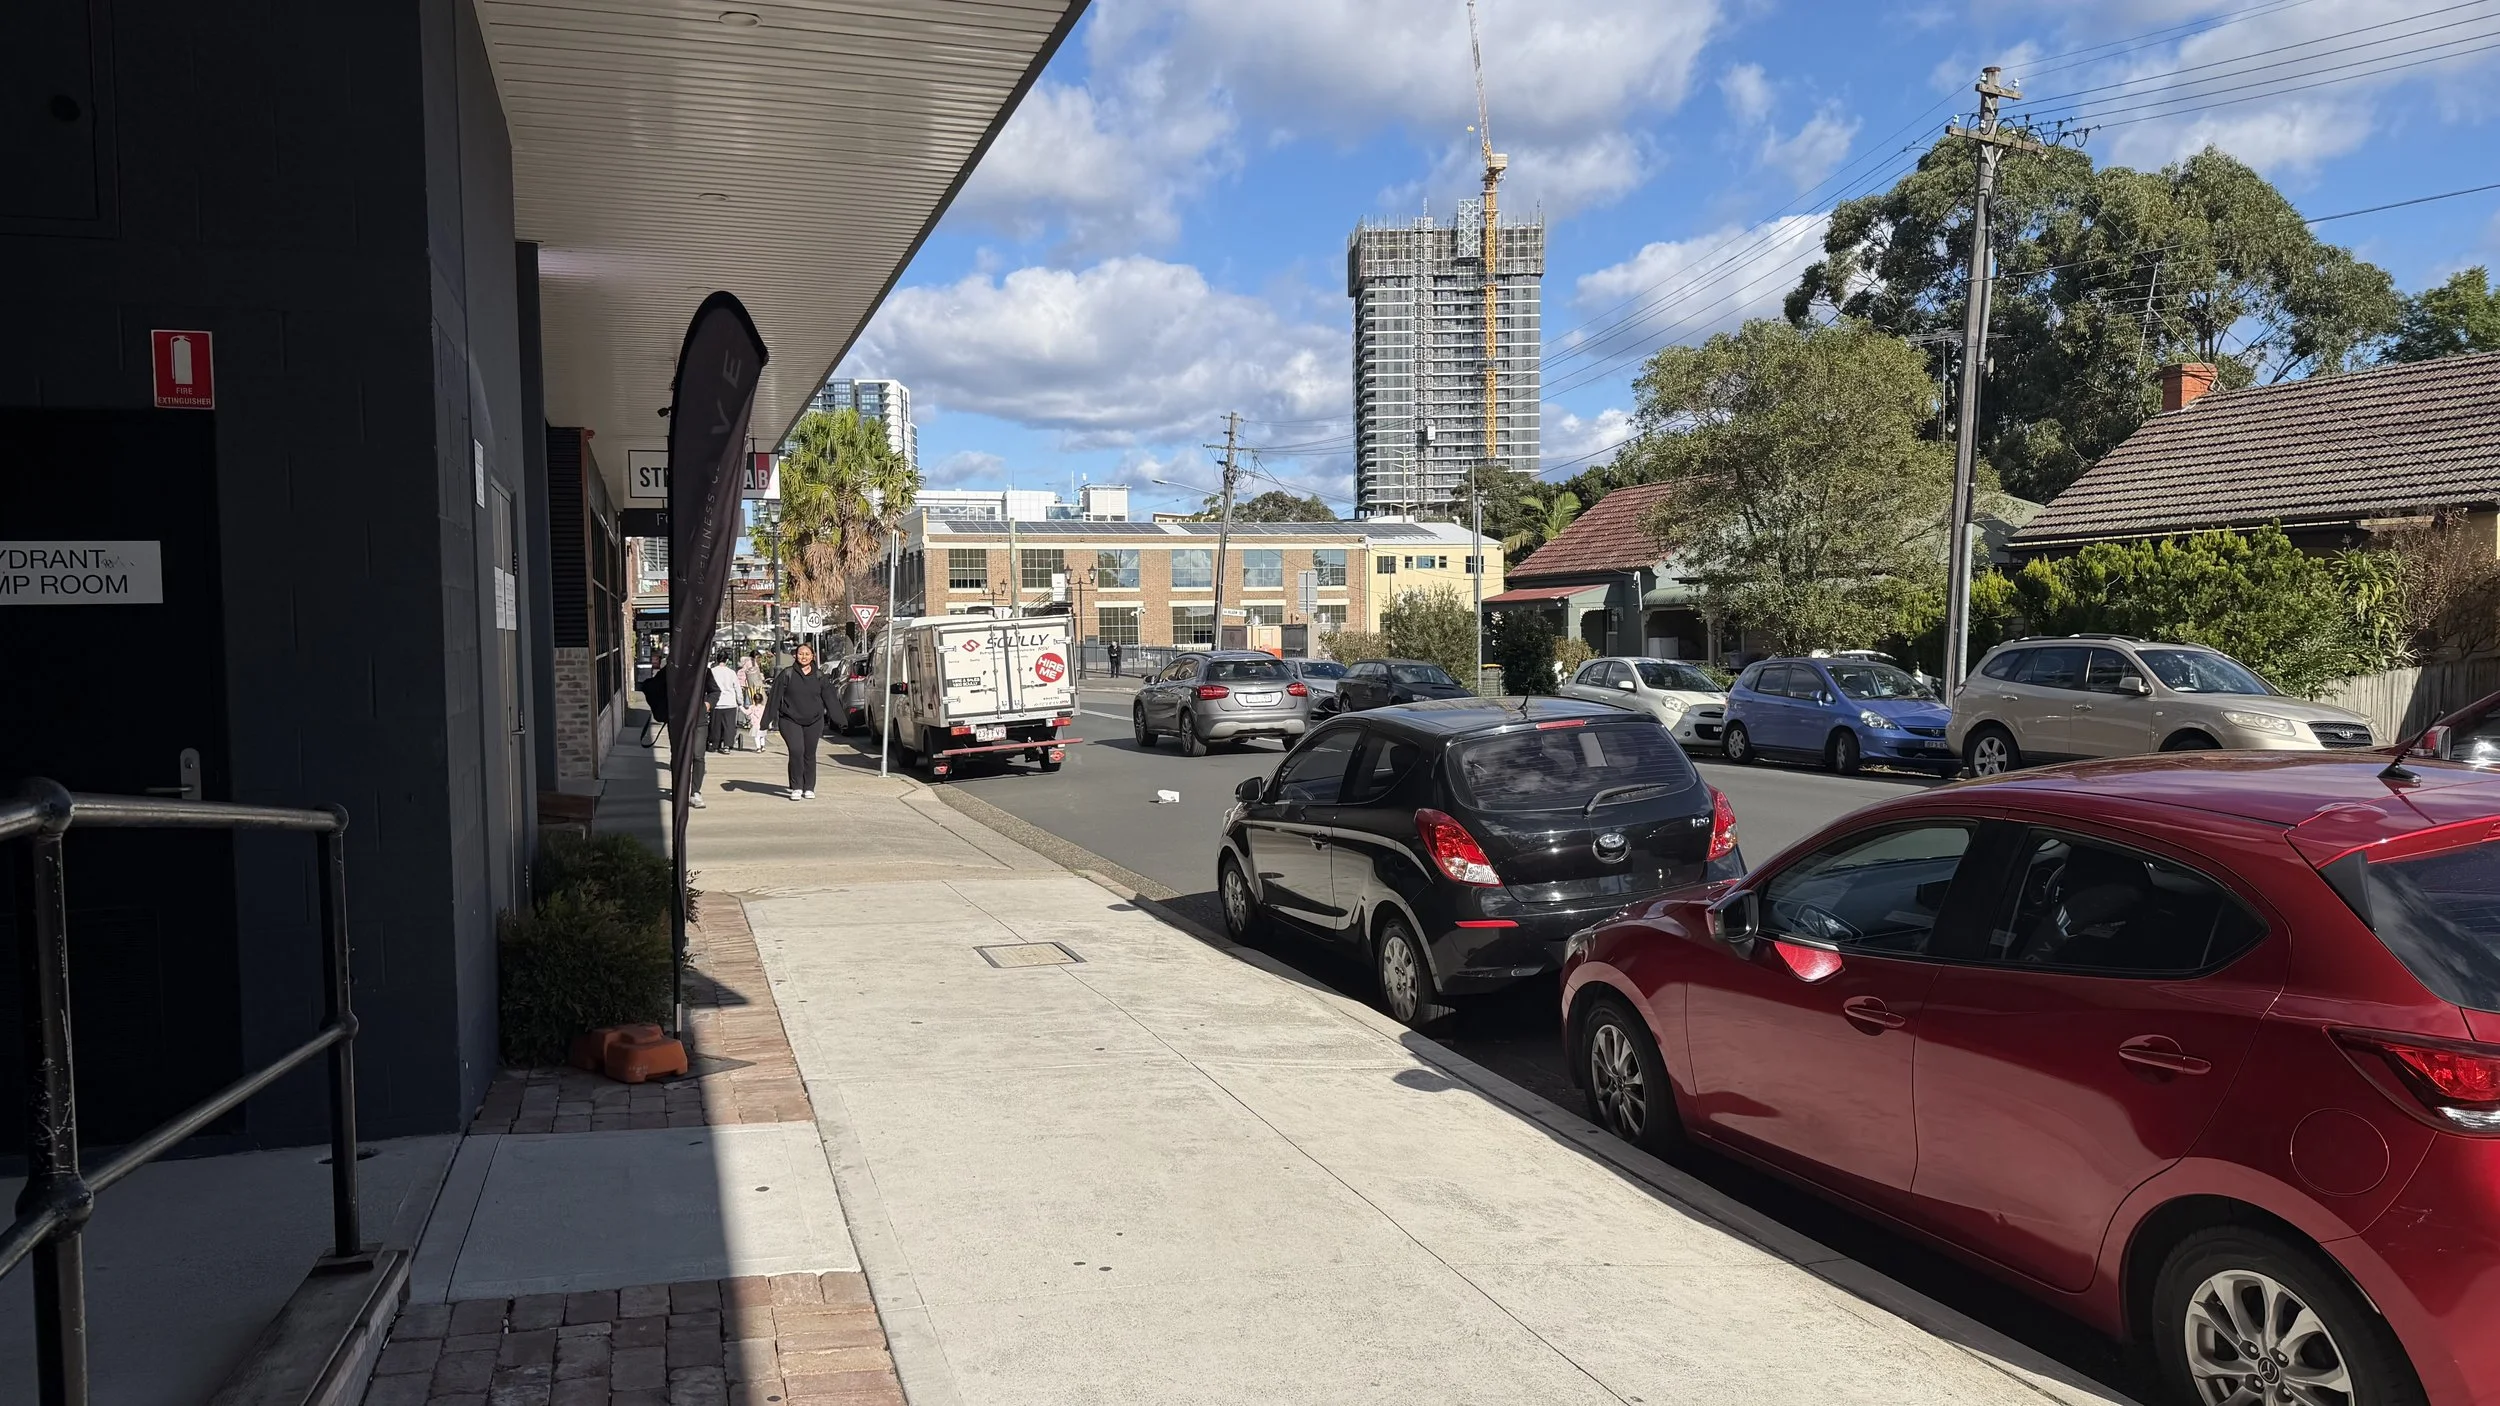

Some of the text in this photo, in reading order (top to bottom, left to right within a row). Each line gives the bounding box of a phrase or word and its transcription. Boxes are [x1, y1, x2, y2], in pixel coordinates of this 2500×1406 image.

[176, 387, 193, 395] FIRE
[158, 396, 212, 405] EXTINGUISHER
[40, 574, 128, 594] ROOM
[808, 615, 820, 625] 40
[984, 634, 1049, 649] SCULLY
[1037, 656, 1065, 674] HIRE
[1038, 668, 1058, 680] ME
